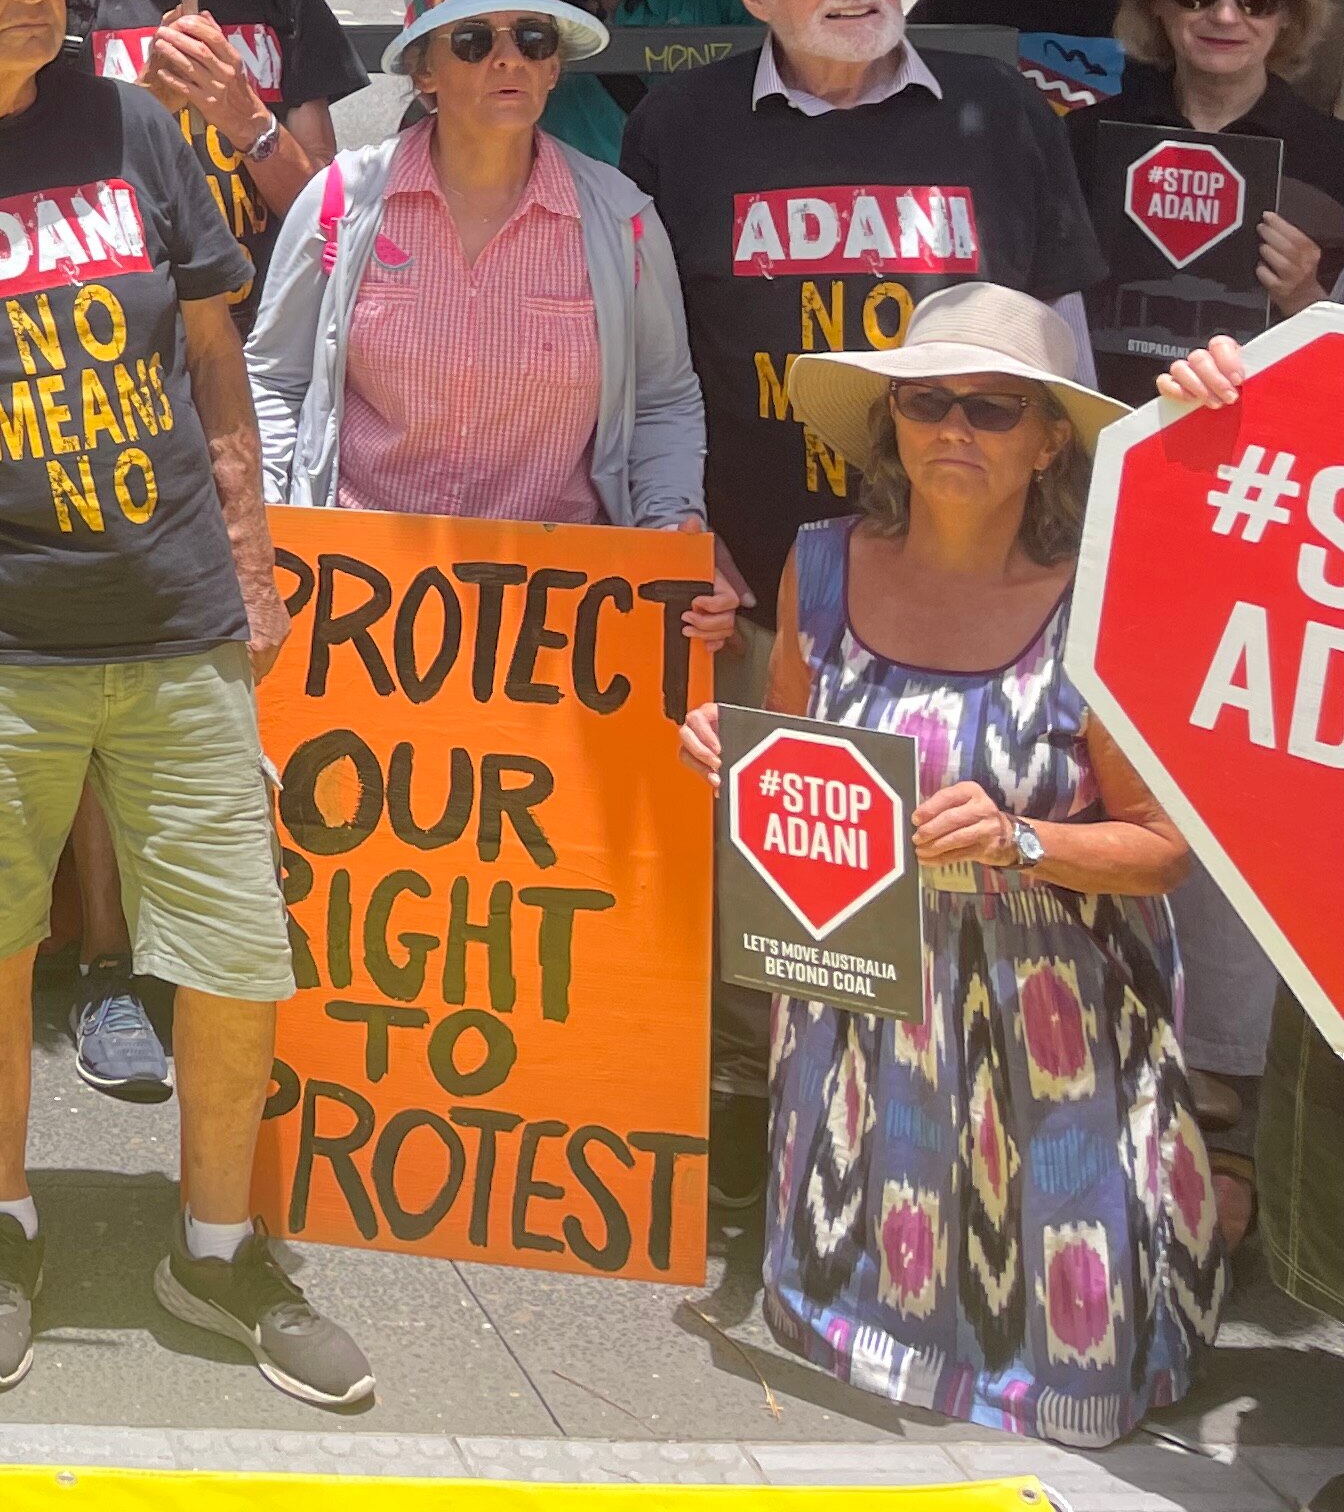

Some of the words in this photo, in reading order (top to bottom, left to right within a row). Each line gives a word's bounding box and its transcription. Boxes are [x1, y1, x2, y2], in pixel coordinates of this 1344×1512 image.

[1147, 193, 1220, 225] ADANI
[1148, 165, 1225, 197] #STOP
[734, 190, 976, 263] ADANI
[5, 284, 127, 375] NO
[801, 281, 914, 351] NO
[46, 447, 158, 533] NO
[280, 730, 555, 870] OUR
[759, 769, 872, 828] #STOP
[763, 811, 869, 871] ADANI
[281, 845, 616, 1023] RIGHT
[743, 932, 779, 956] LET'S
[781, 941, 820, 965] MOVE
[822, 950, 897, 981] AUSTRALIA
[765, 956, 828, 987] BEYOND
[833, 971, 876, 998] COAL
[325, 1000, 517, 1096] TO
